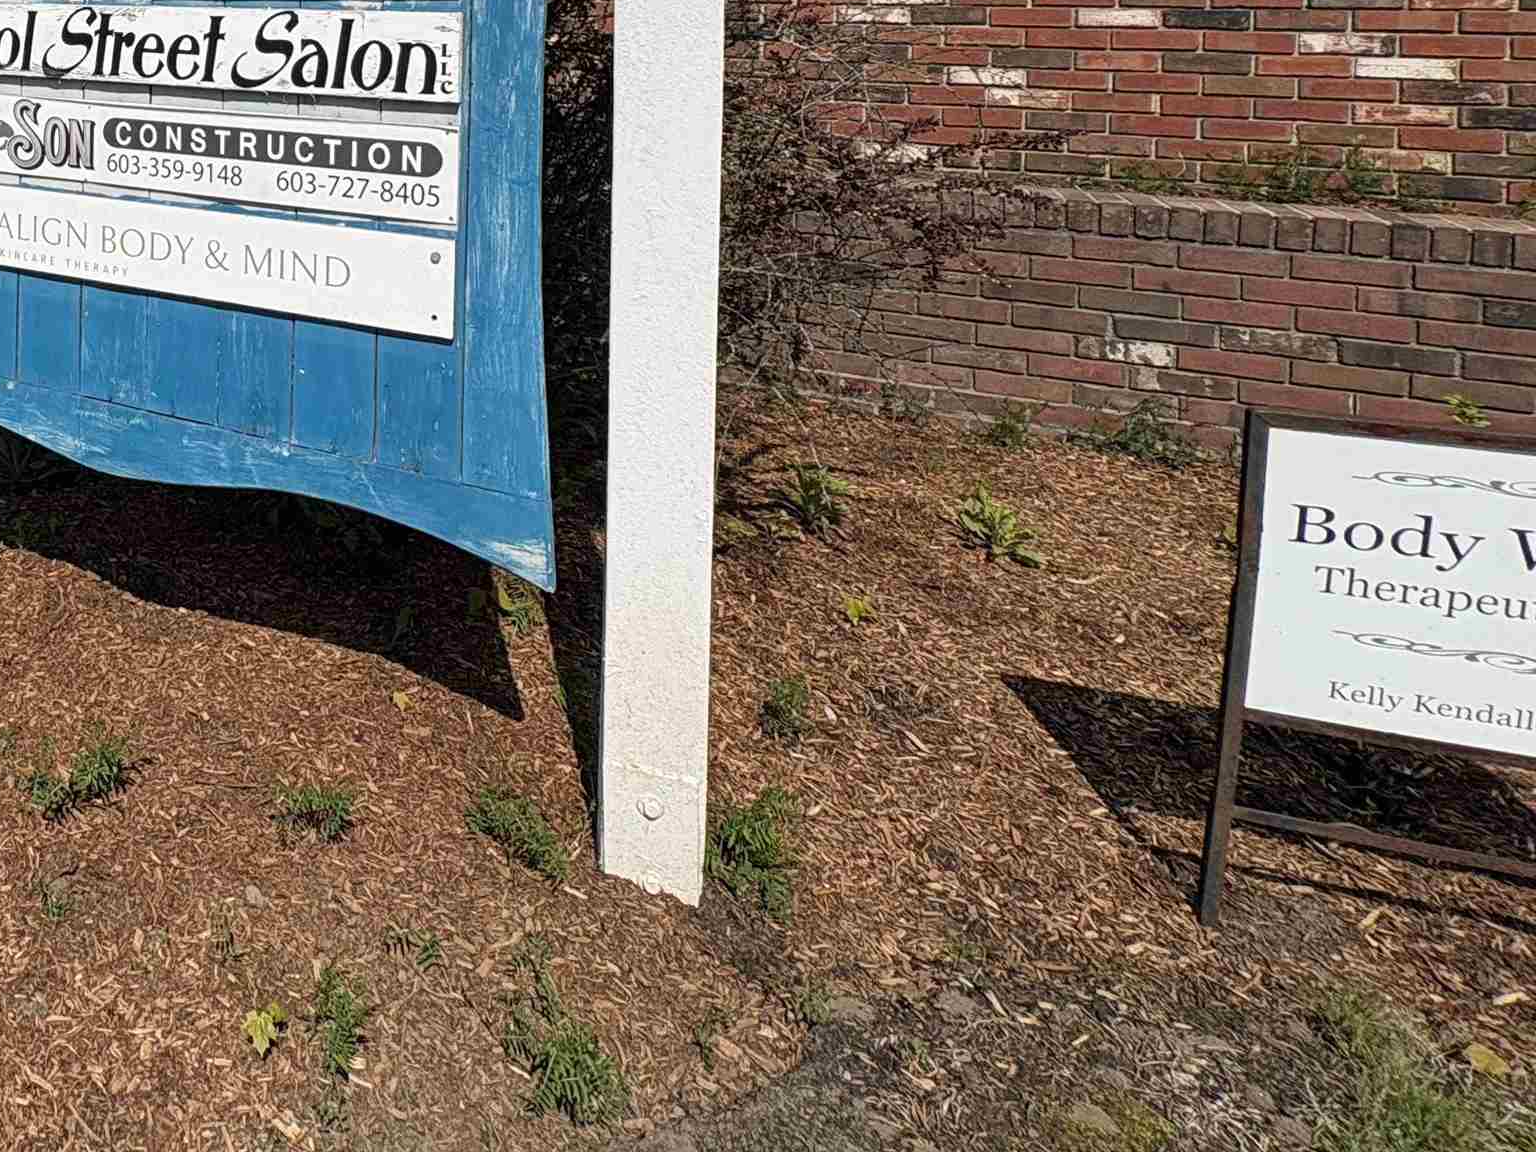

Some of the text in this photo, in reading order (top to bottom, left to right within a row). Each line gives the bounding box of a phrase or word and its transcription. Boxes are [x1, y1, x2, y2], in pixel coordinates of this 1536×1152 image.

[42, 7, 226, 82] Street
[231, 11, 438, 95] Salon
[115, 121, 422, 174] CONSTRUCTION
[107, 153, 440, 207] 603-359-9148 603-727-8405
[65, 258, 129, 277] THERAPY
[101, 224, 194, 265] BODY
[204, 239, 231, 272] &
[243, 244, 351, 288] MIND
[1288, 503, 1485, 572] Body
[1314, 564, 1536, 620] Therapeu
[1327, 679, 1404, 713] Kelly
